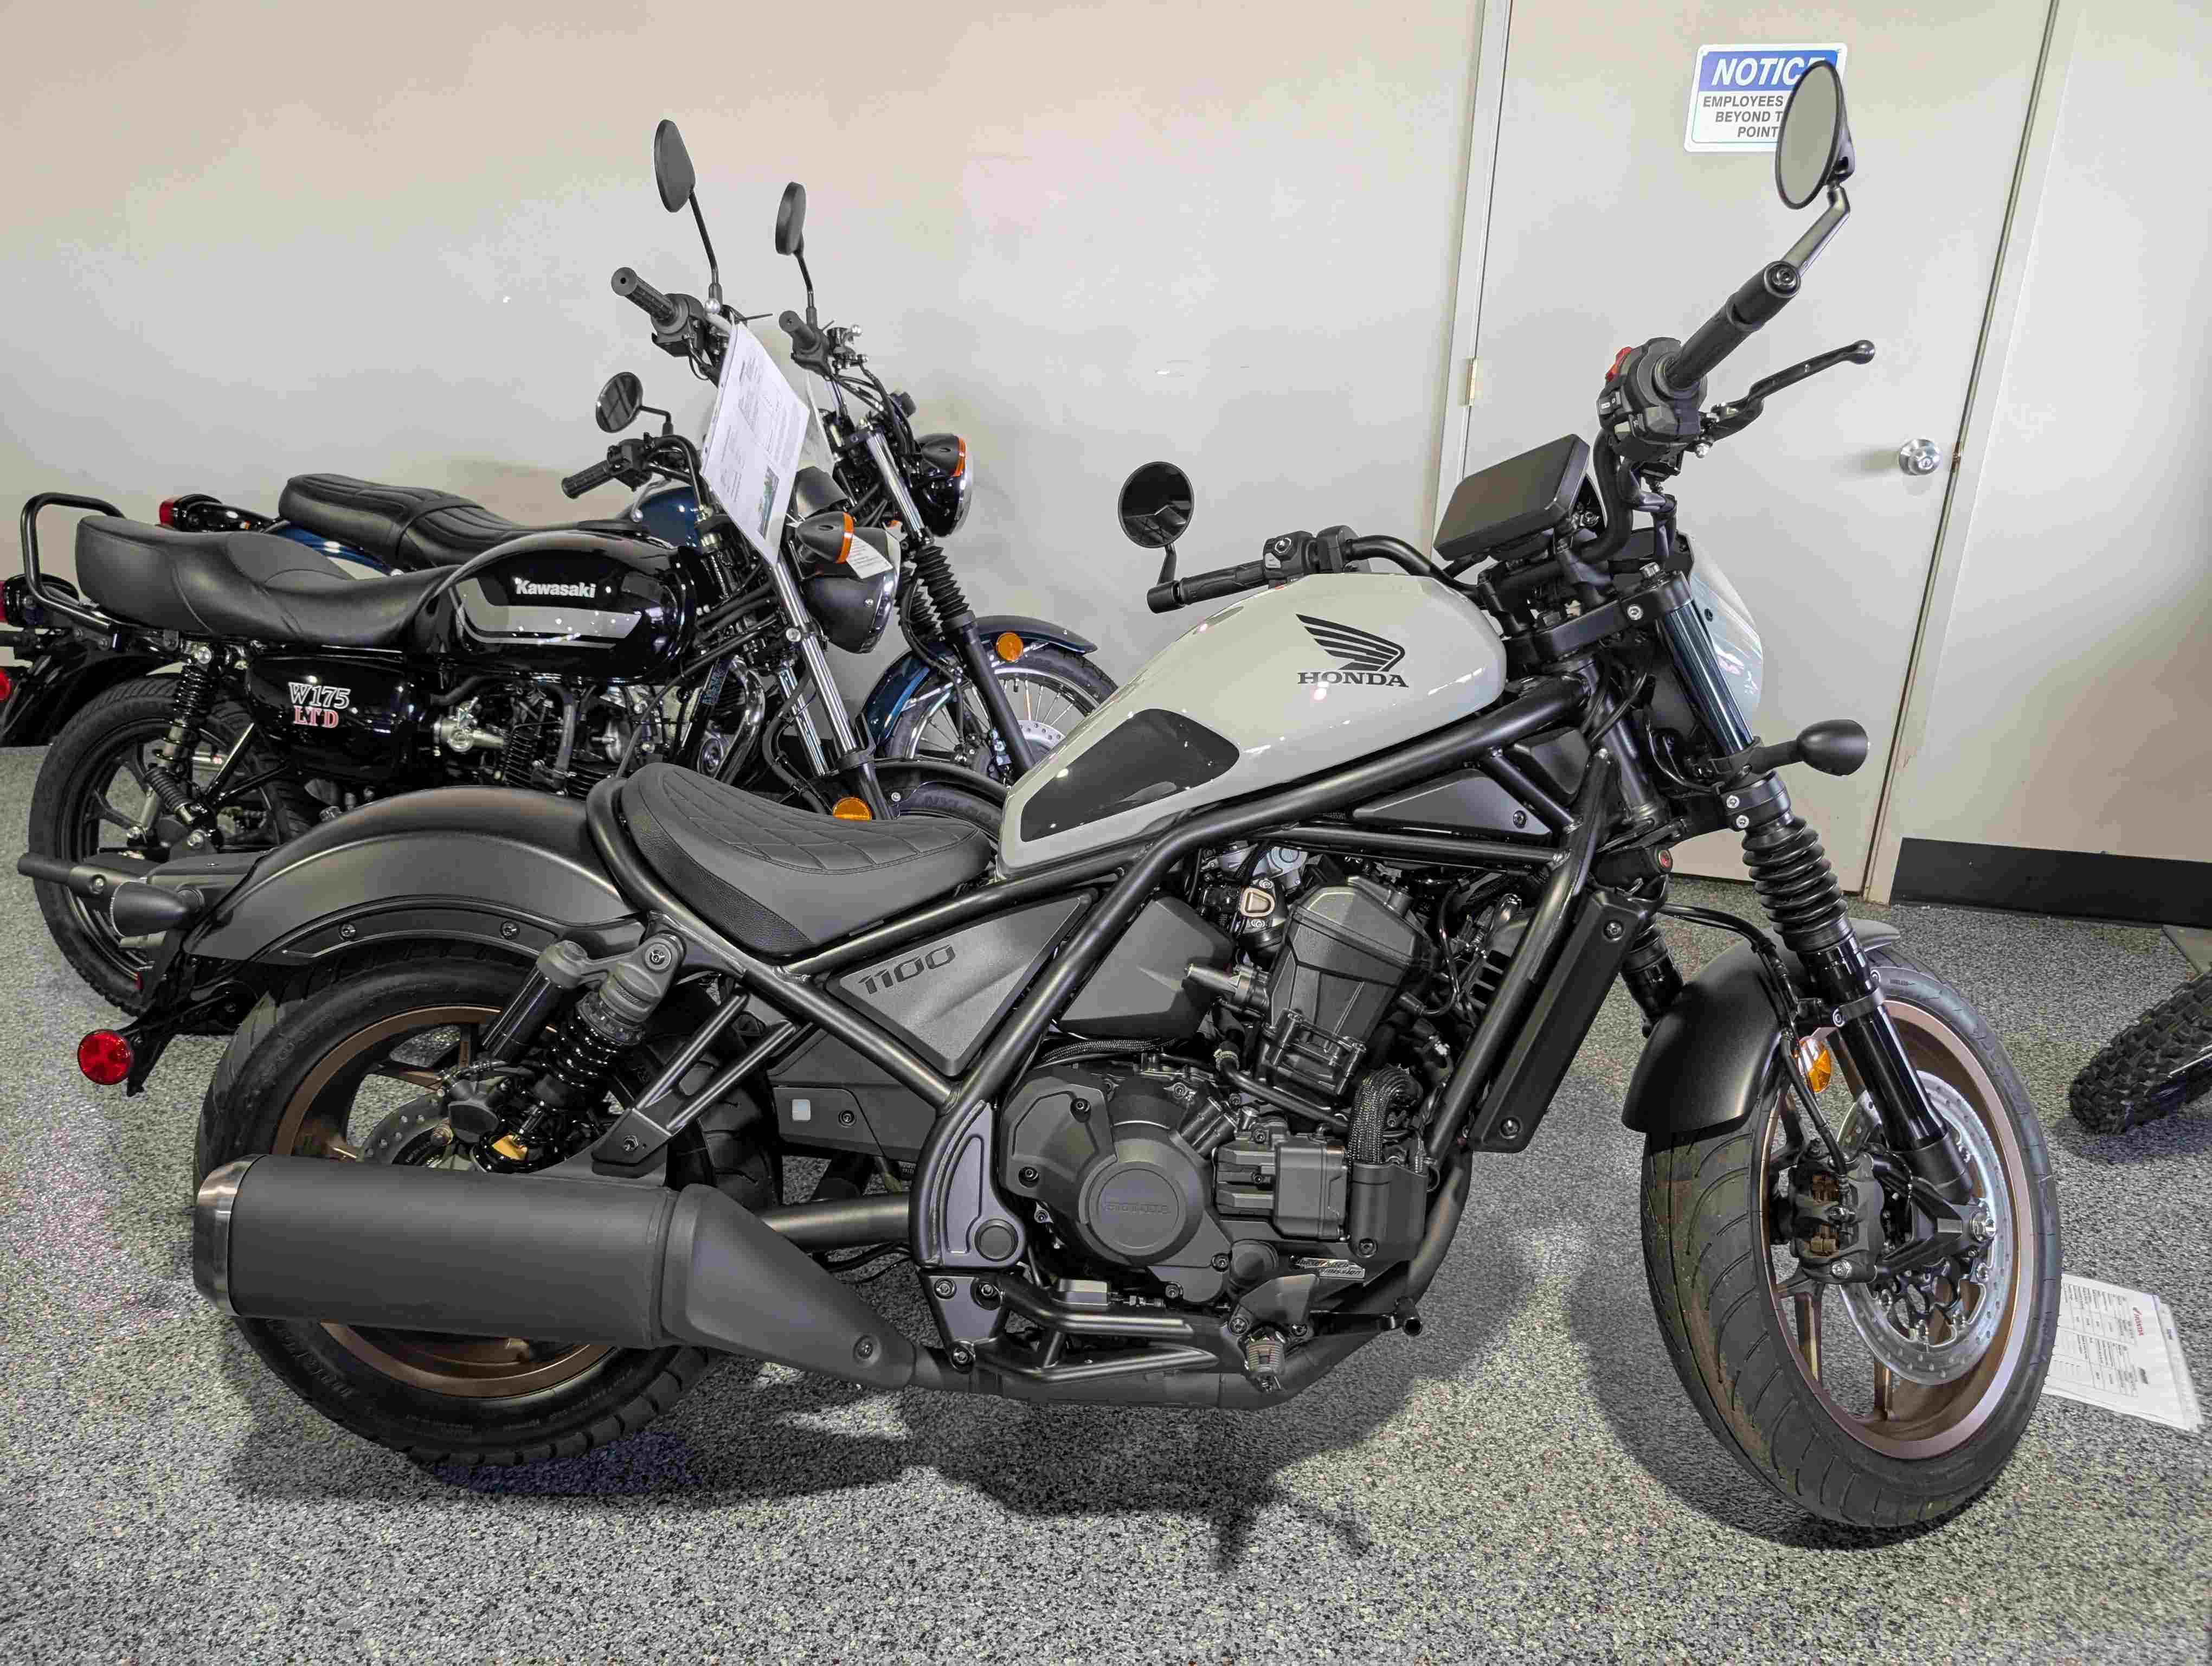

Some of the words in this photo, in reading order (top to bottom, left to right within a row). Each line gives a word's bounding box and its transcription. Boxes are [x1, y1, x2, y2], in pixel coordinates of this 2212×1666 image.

[1711, 57, 1825, 86] NOTIC
[1702, 95, 1784, 108] EMPLOYEES
[1715, 111, 1771, 123] BEYOND
[1737, 126, 1779, 138] POINT
[515, 579, 596, 598] Kawasaki
[1297, 671, 1409, 688] HONDA
[287, 681, 351, 710] W175
[293, 704, 339, 729] LTD
[858, 944, 956, 995] 1100
